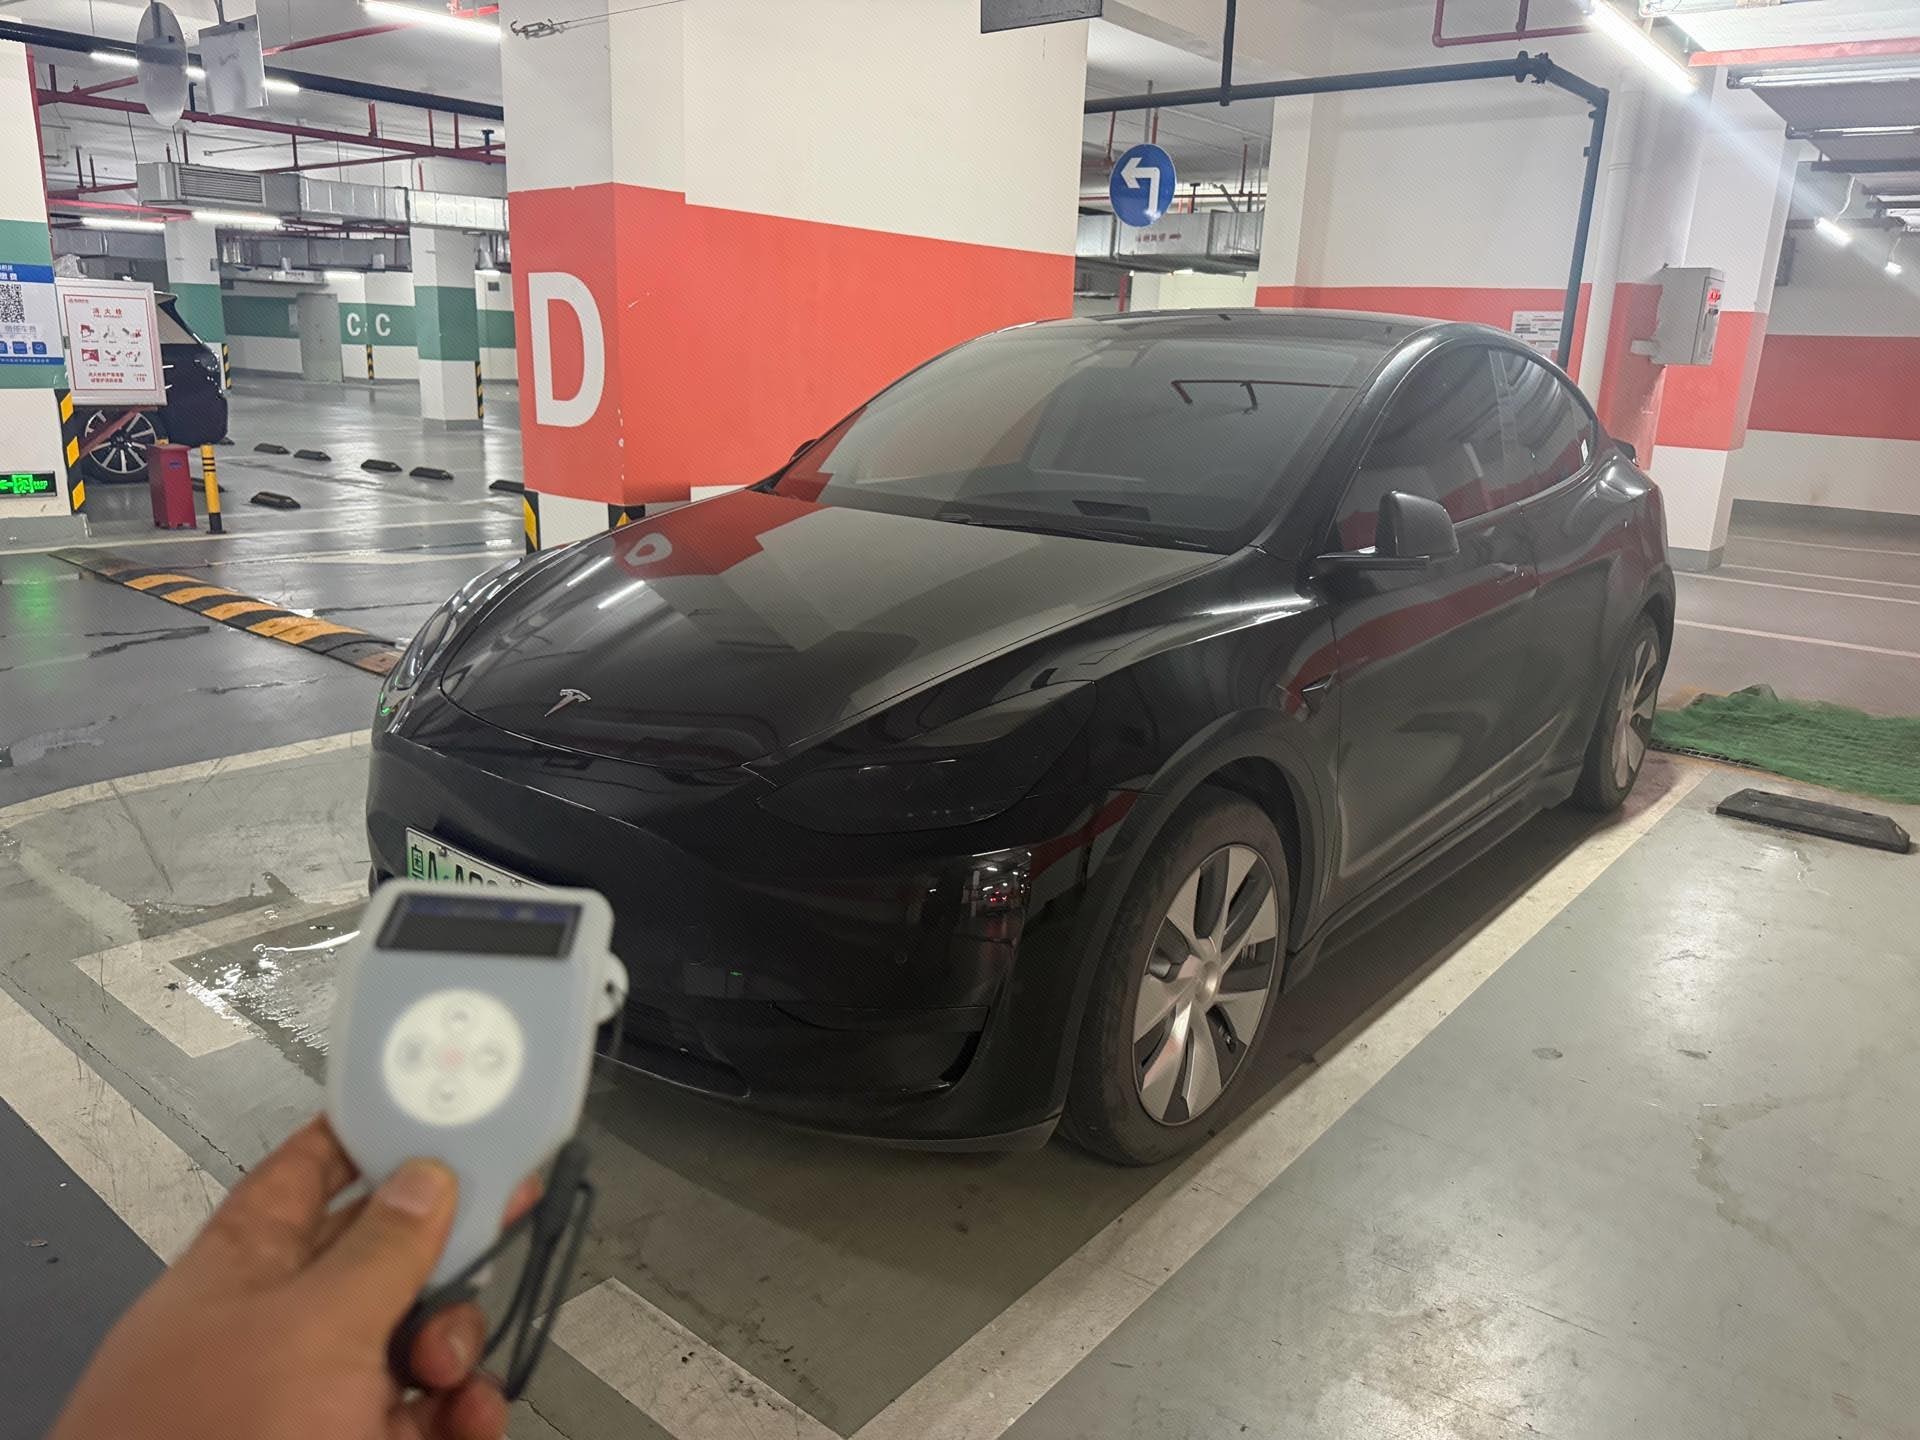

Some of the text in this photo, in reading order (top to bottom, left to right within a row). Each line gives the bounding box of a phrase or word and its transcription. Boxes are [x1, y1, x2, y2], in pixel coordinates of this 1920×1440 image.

[346, 312, 361, 336] C
[375, 313, 391, 337] C
[528, 272, 606, 428] D
